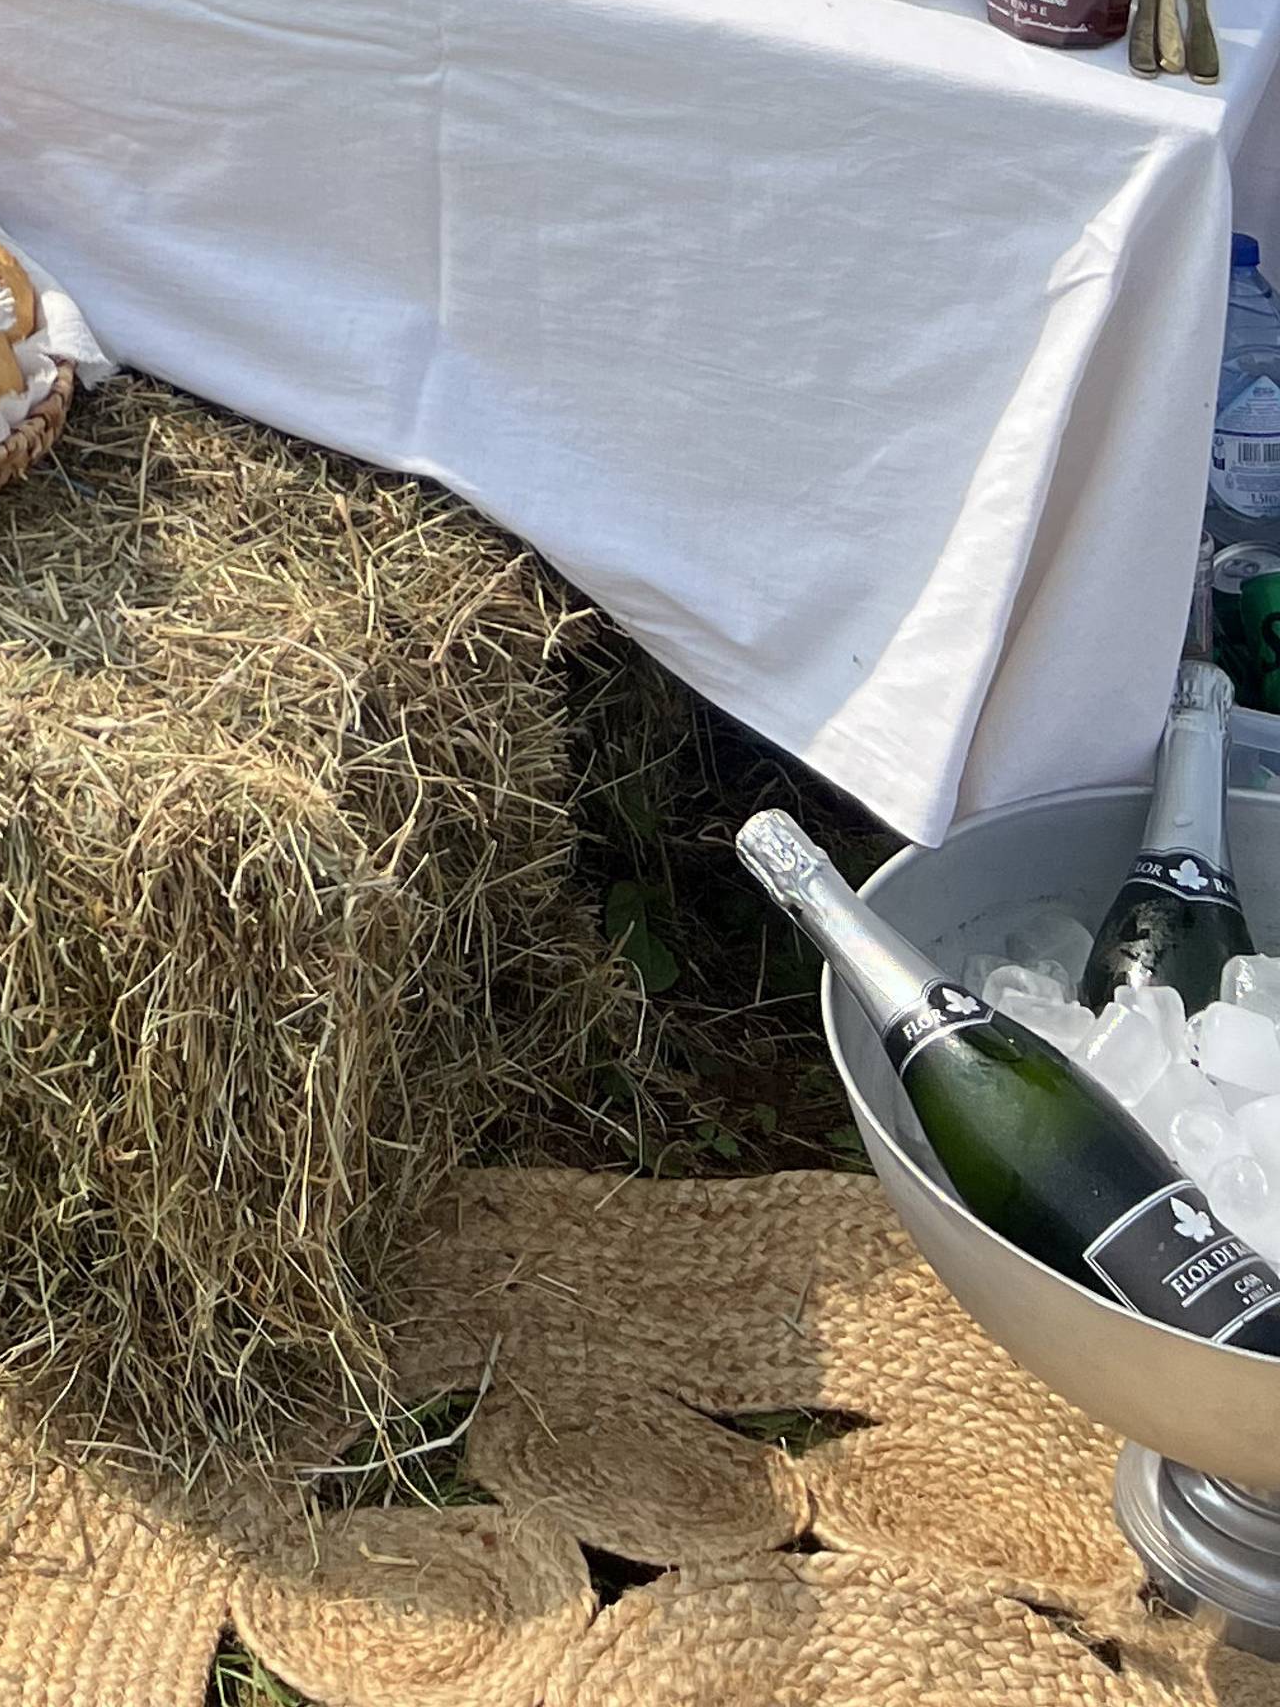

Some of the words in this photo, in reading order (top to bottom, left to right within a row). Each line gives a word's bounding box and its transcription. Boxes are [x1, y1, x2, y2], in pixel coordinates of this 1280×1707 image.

[1134, 860, 1163, 877] LOR
[902, 1008, 947, 1041] FLOR
[1170, 1258, 1218, 1297] FLOR
[1211, 1245, 1237, 1267] DE
